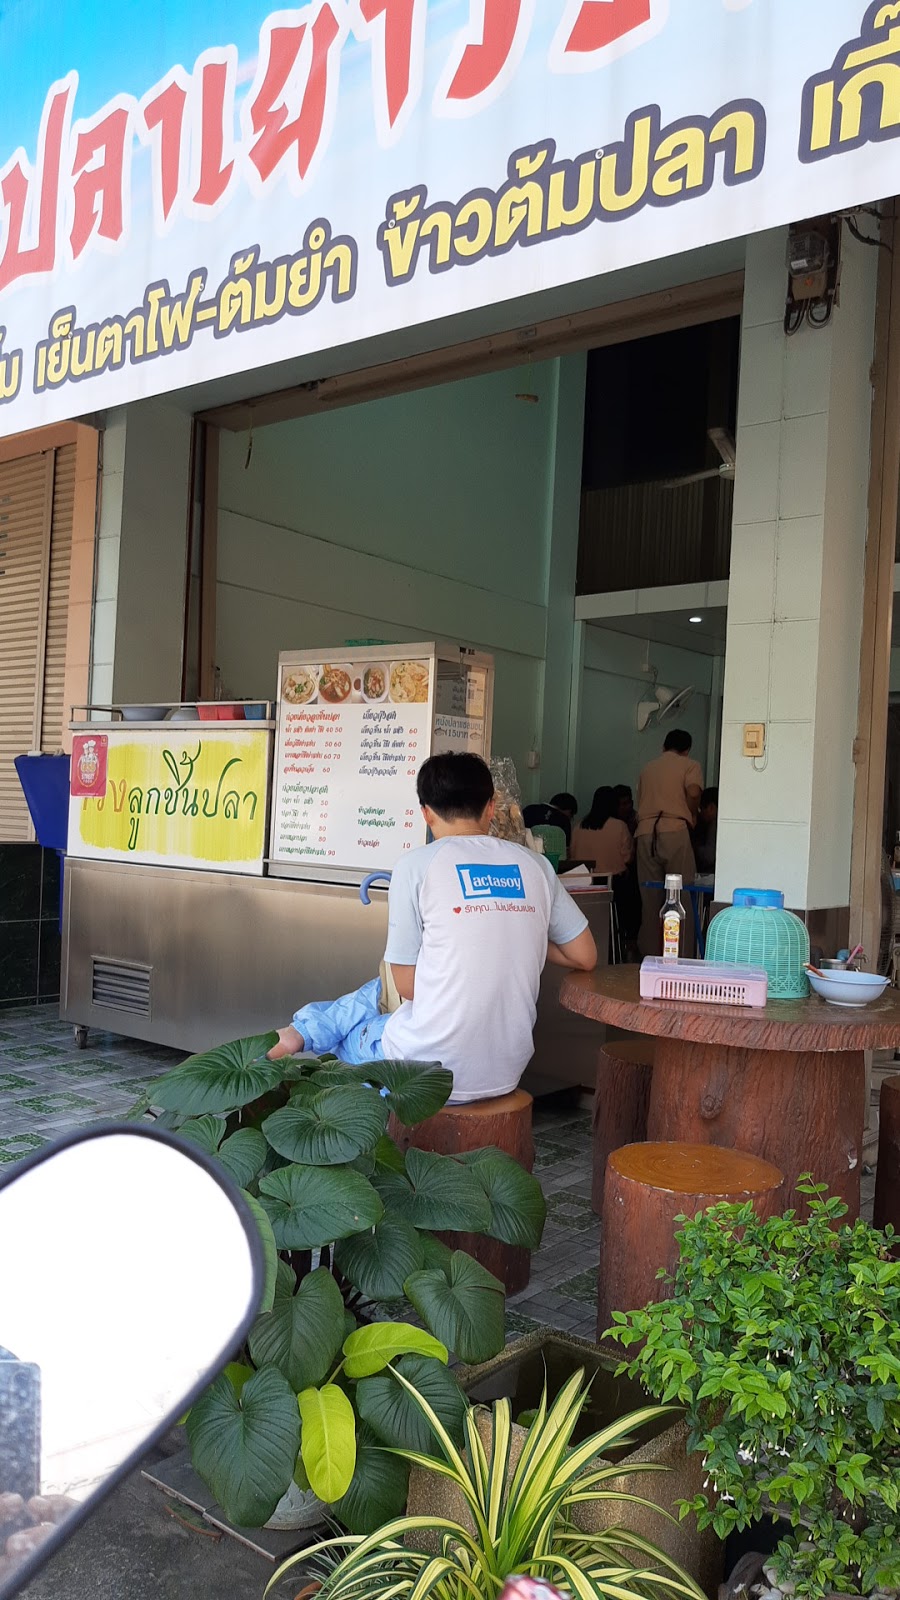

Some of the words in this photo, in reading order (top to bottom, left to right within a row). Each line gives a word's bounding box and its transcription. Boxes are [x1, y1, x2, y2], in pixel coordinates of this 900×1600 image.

[36, 224, 353, 389] เย็นตาโฟ-ต้มยำ
[383, 109, 756, 278] ข้าวต้มปลา
[459, 869, 521, 897] Lactasoy
